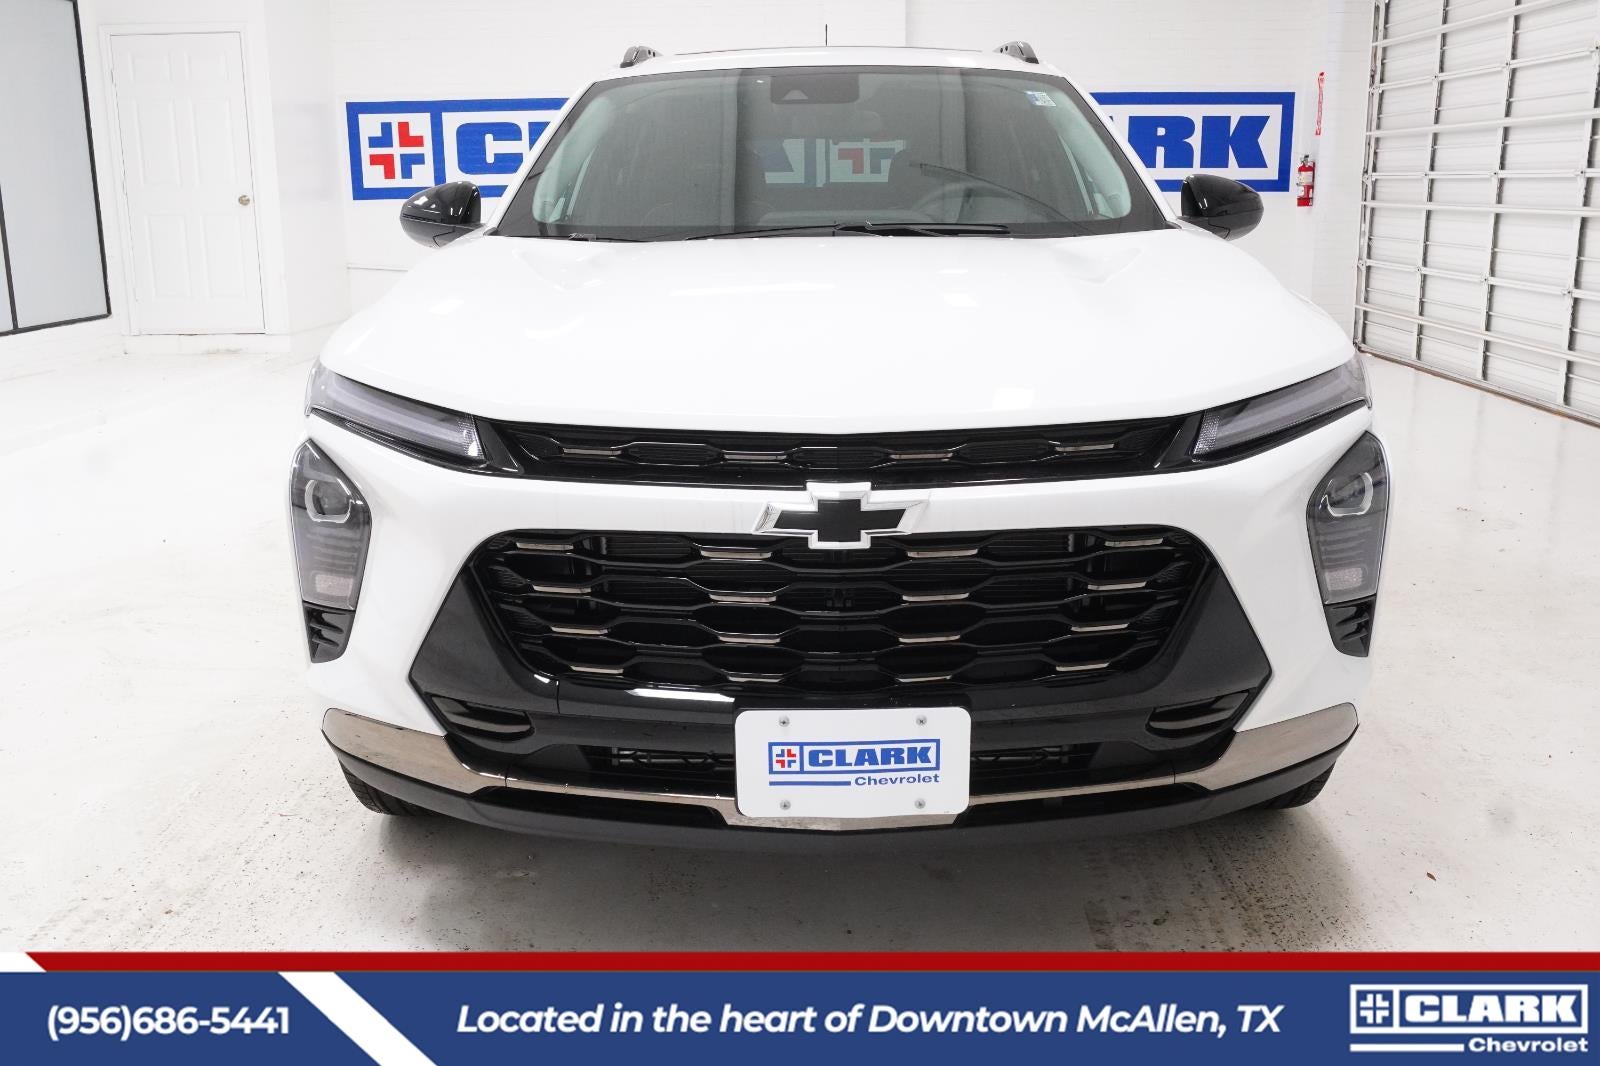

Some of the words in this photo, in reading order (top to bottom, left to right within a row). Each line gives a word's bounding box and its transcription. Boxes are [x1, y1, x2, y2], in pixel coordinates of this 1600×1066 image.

[1109, 114, 1271, 169] RK
[808, 746, 932, 768] CLARK
[854, 773, 940, 786] Chevrolet
